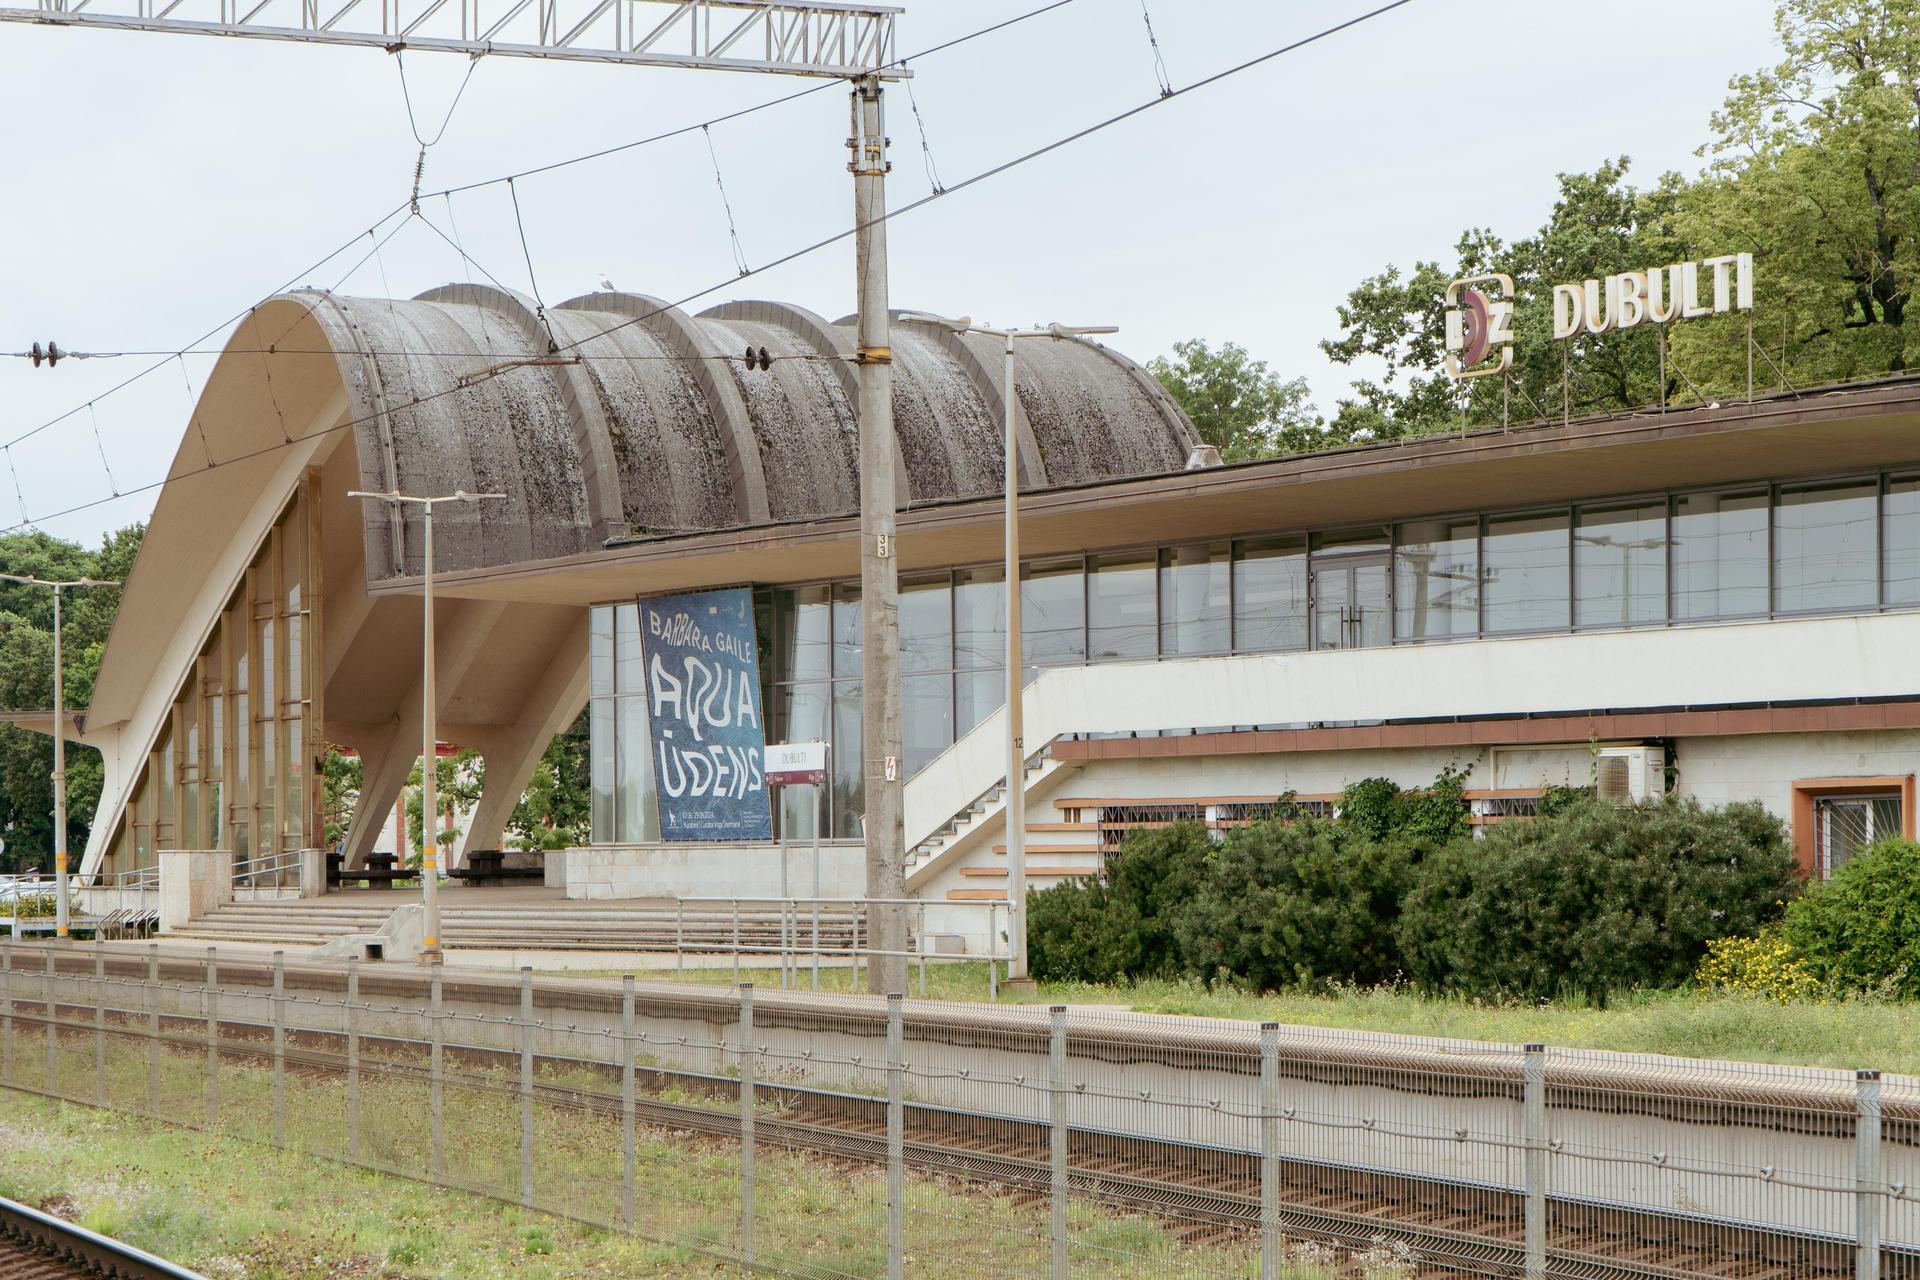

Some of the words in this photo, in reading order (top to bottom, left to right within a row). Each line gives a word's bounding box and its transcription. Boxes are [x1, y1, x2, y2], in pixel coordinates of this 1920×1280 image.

[1553, 252, 1753, 339] DUBULTI
[650, 610, 713, 653] BARBARA
[715, 631, 752, 664] GAILE
[651, 652, 757, 741] AQUA
[660, 729, 762, 799] ŪDENS
[1014, 737, 1023, 749] 12
